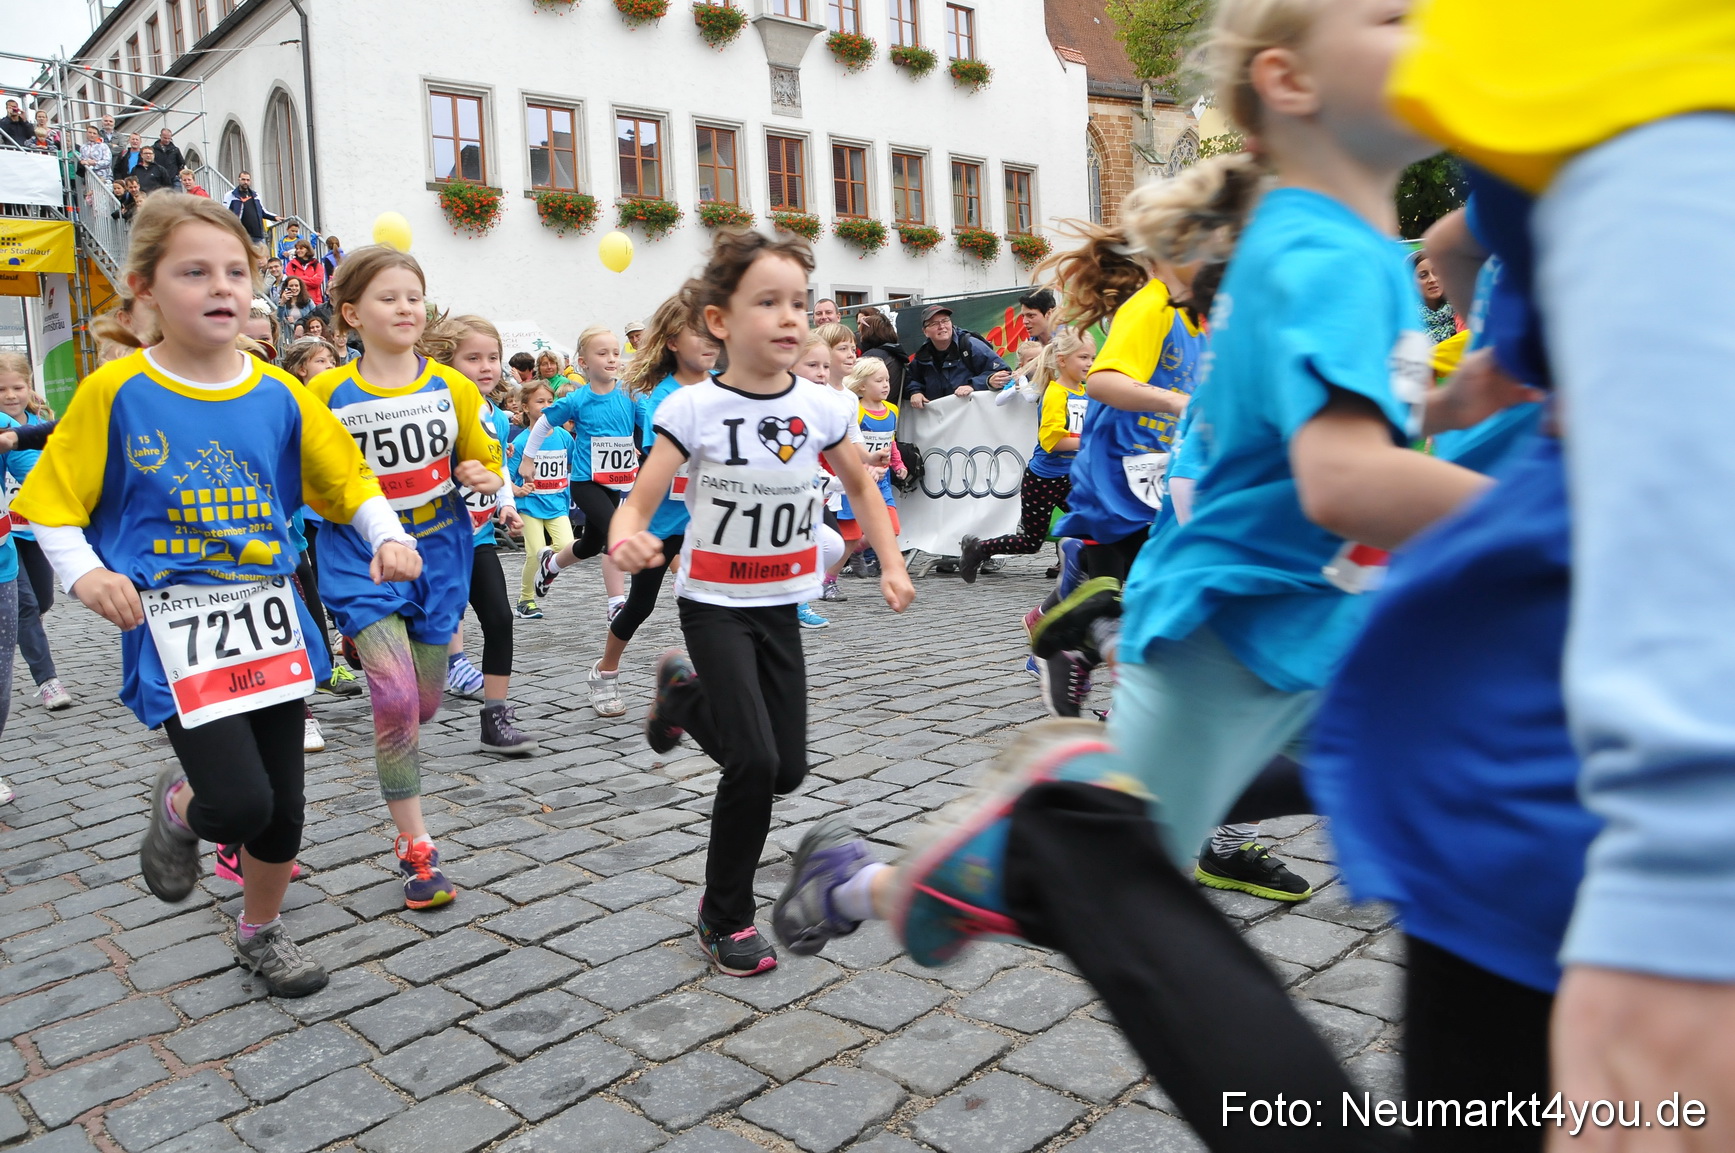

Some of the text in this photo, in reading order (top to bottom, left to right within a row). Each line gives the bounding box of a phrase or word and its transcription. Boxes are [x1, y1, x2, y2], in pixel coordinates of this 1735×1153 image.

[11, 247, 51, 256] Stadtlauf
[340, 405, 433, 427] ARTL Neumarkt
[138, 435, 150, 444] 15
[723, 418, 749, 466] I
[134, 448, 160, 457] Jahre
[701, 475, 748, 494] PARTL
[249, 523, 273, 533] 2014
[712, 497, 815, 548] 7104
[729, 562, 789, 579] Milena
[149, 597, 206, 617] PARTL
[168, 596, 292, 667] 7219
[229, 669, 266, 693] Jule
